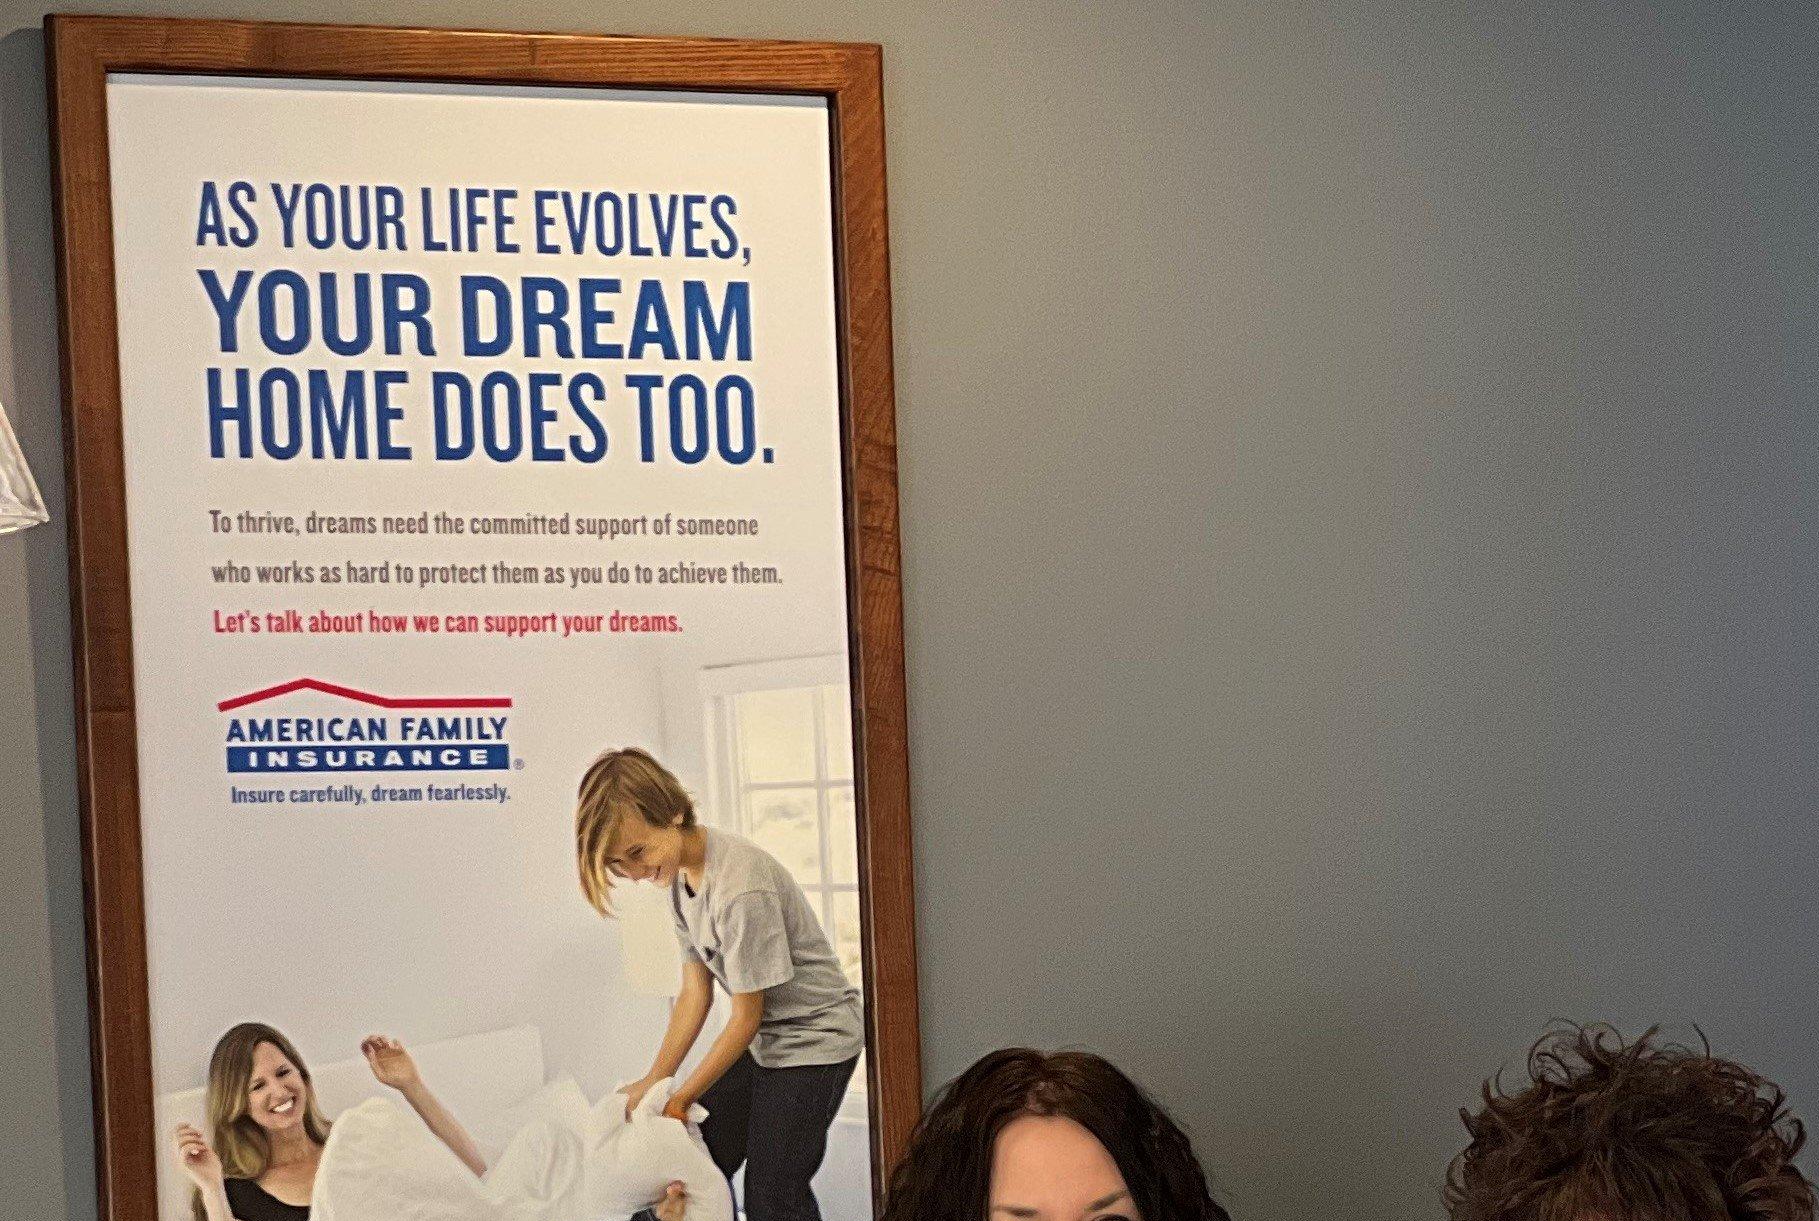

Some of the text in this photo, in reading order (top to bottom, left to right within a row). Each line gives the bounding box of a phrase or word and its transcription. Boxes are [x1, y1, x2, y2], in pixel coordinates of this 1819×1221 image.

[196, 181, 751, 266] AS YOUR LIFE EVOLVES,
[196, 269, 753, 361] YOUR DREAM
[206, 367, 774, 465] HOME DOES TOO.
[209, 509, 758, 539] To thrive, dreams need the committed support of someone
[211, 561, 783, 588] who works as hard to protect them as you do to achieve them.
[214, 609, 682, 637] Let's talk about how we can support your dreams.
[226, 717, 508, 742] AMERICAN FAMILY
[248, 748, 488, 768] INSURANCE
[232, 783, 511, 805] Insure carefully, dream fearlessly.
